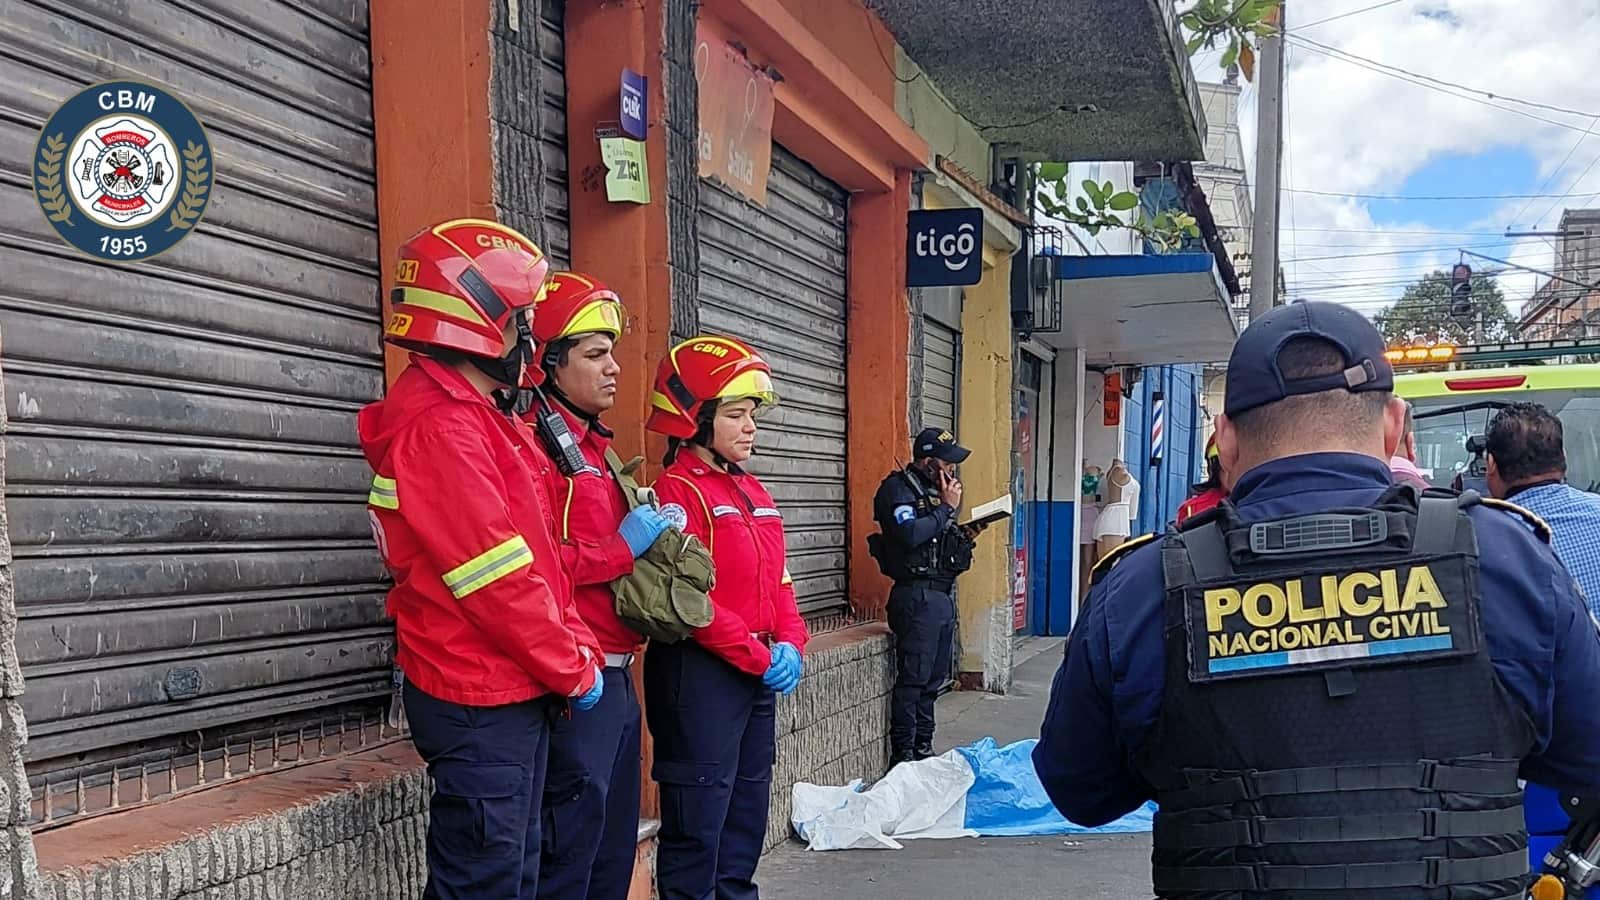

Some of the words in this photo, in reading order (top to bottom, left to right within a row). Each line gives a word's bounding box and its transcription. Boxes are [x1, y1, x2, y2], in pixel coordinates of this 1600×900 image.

[475, 233, 522, 254] CBM
[692, 342, 729, 359] CBM
[1204, 566, 1448, 632] POLICIA
[1208, 622, 1363, 657] NACIONAL
[1369, 610, 1450, 639] CIVIL
